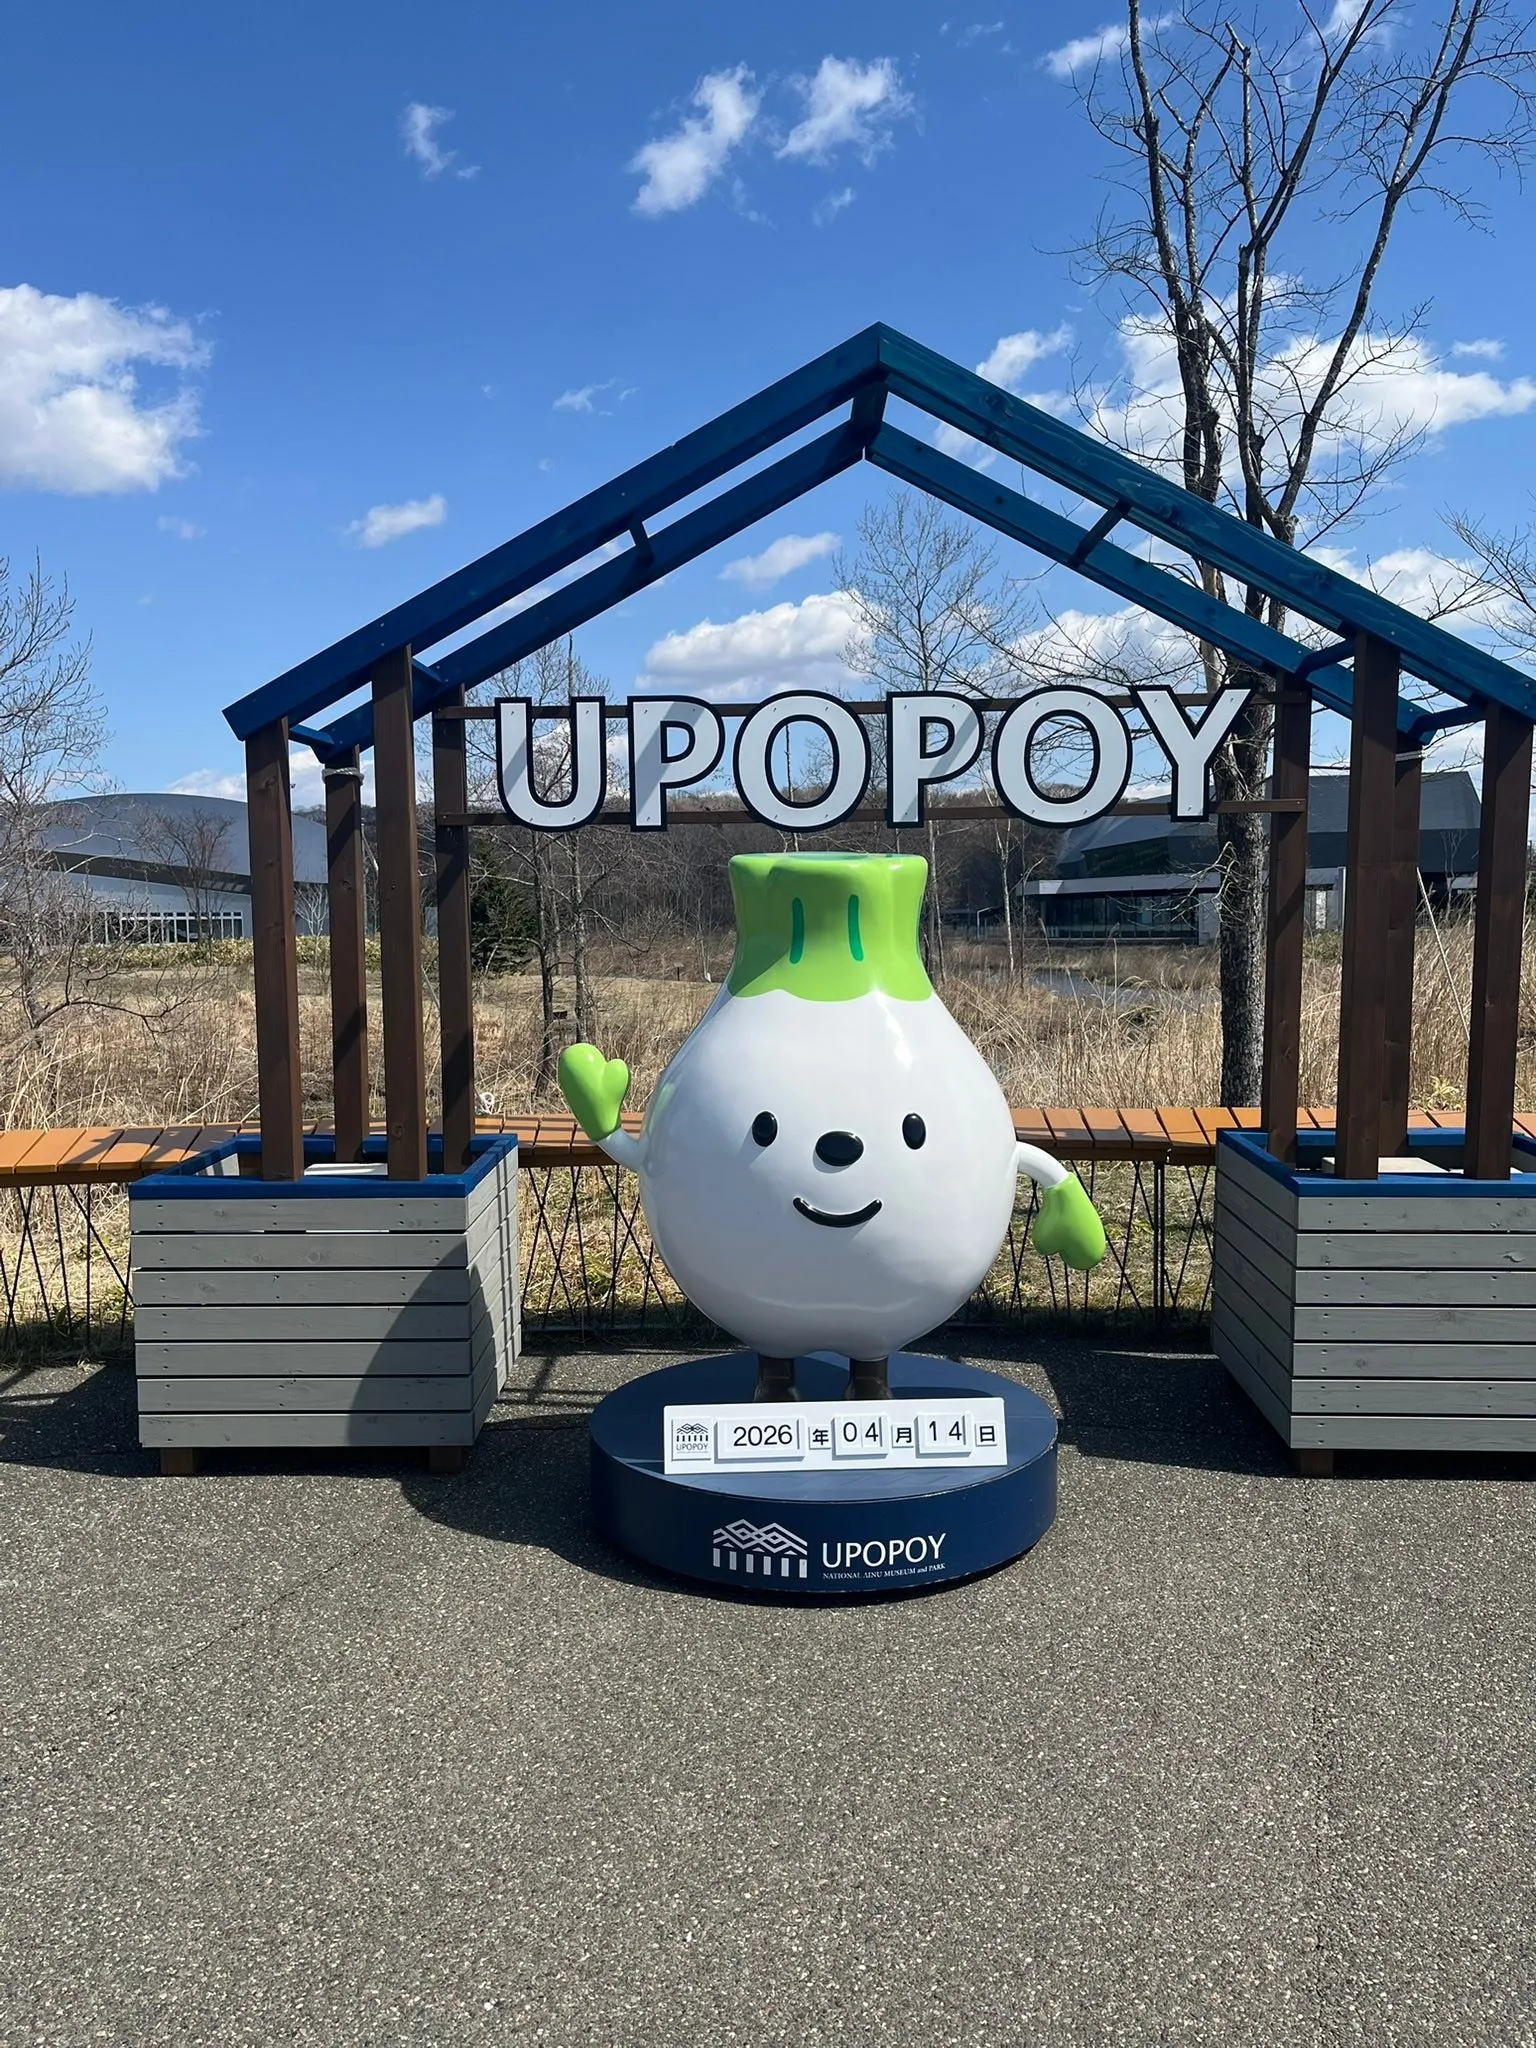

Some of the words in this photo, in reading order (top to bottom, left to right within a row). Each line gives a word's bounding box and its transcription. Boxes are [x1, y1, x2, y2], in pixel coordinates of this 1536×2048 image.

[495, 684, 1257, 833] UPOPOY
[676, 1442, 709, 1451] UPOPOY
[822, 1532, 946, 1569] UPOPOY
[822, 1572, 861, 1580] NATIONAL
[863, 1571, 883, 1579] AINU
[884, 1567, 916, 1577] MUSEUM
[917, 1565, 928, 1574] and
[928, 1562, 946, 1572] PARK
